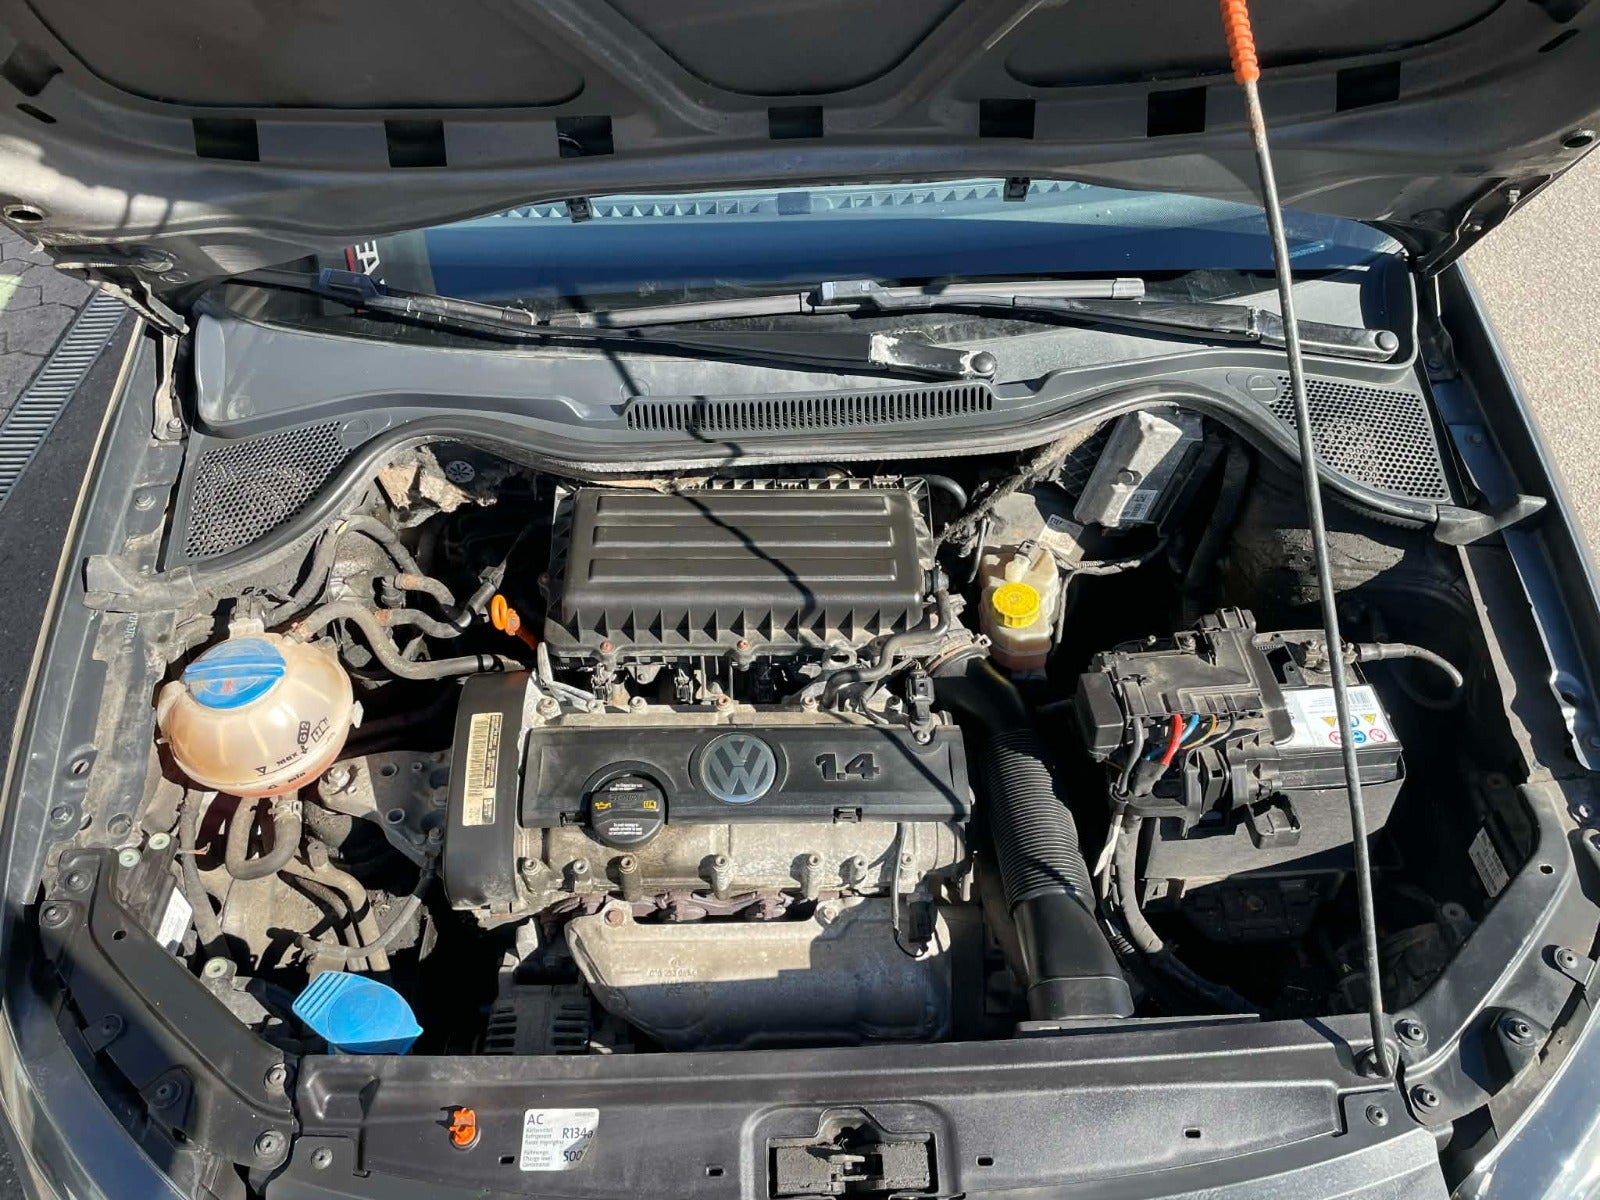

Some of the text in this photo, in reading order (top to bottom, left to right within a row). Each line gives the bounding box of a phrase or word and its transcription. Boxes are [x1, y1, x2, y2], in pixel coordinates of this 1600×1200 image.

[300, 720, 310, 743] G12
[815, 752, 880, 781] 1.4
[526, 1113, 545, 1125] AC
[562, 1127, 594, 1139] R134a
